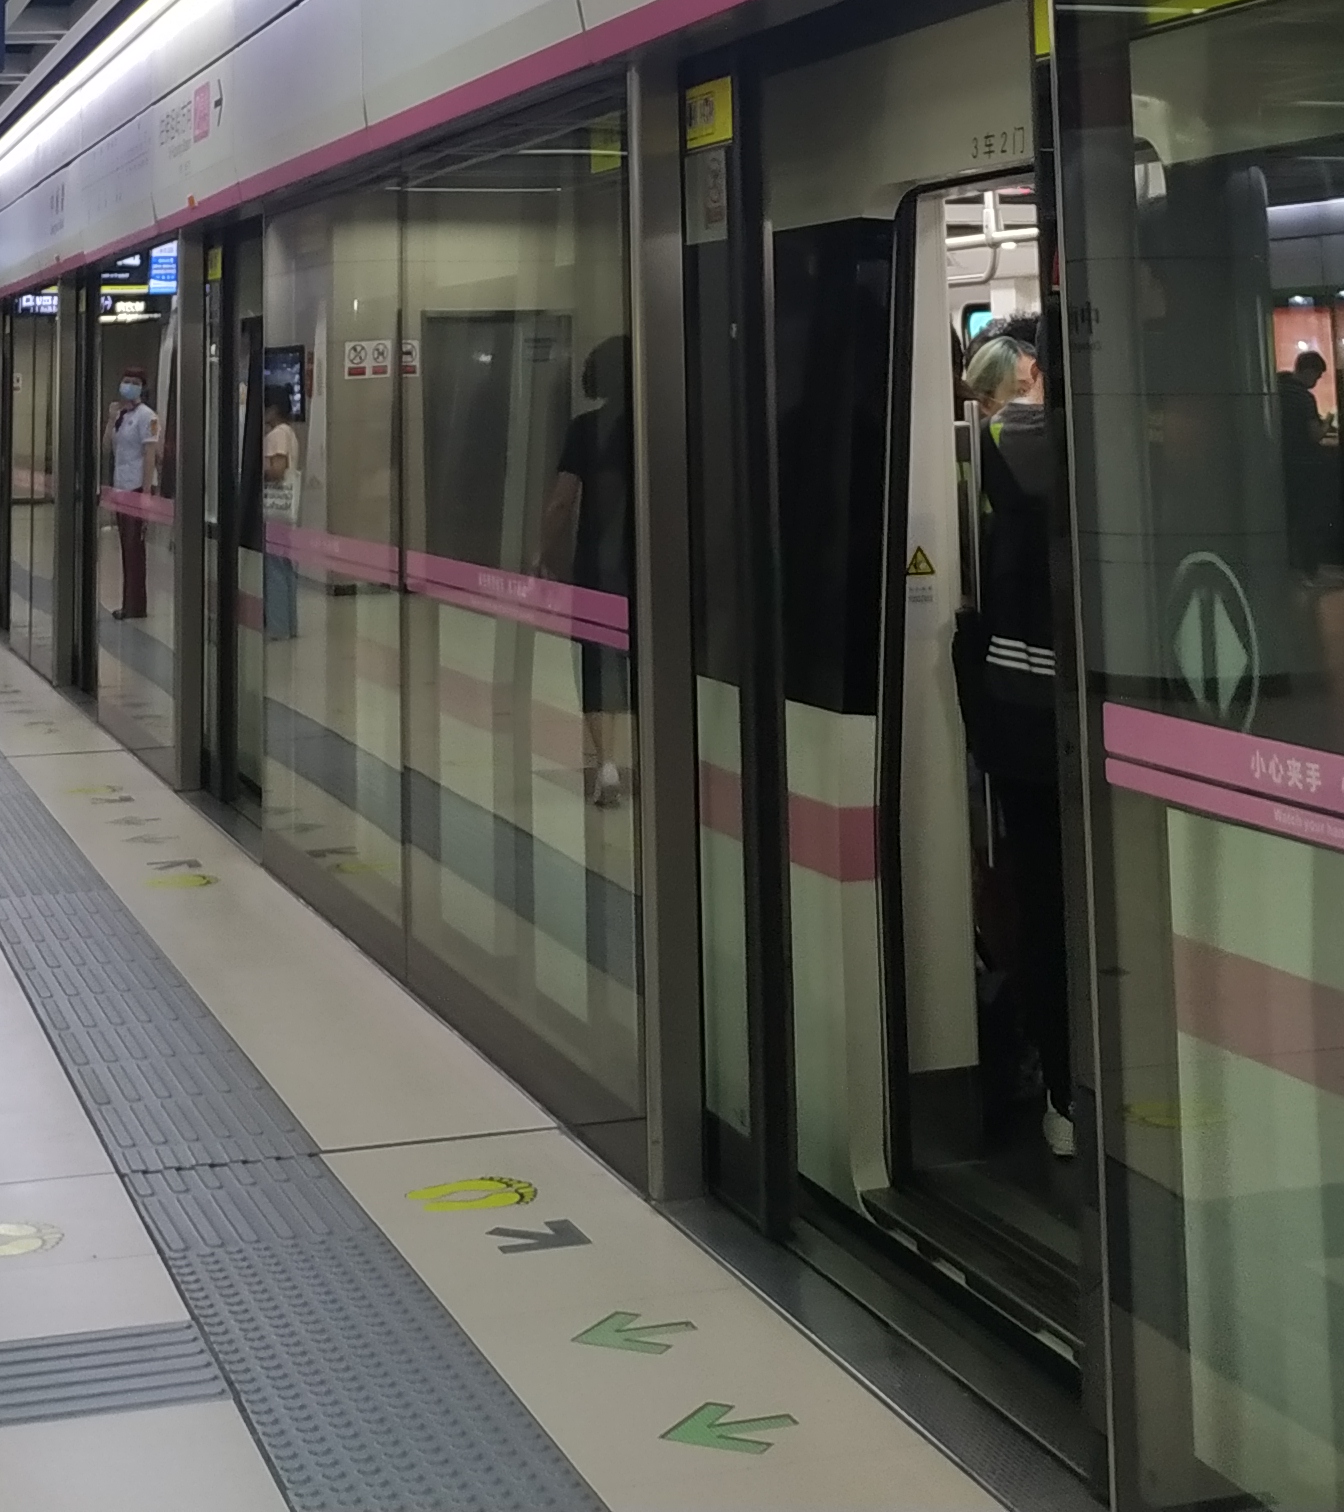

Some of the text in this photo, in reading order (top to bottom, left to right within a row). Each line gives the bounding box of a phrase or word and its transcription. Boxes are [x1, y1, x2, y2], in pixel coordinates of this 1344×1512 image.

[1250, 748, 1322, 793] 小心夹手
[1272, 807, 1304, 827] Watch
[1304, 815, 1326, 834] your
